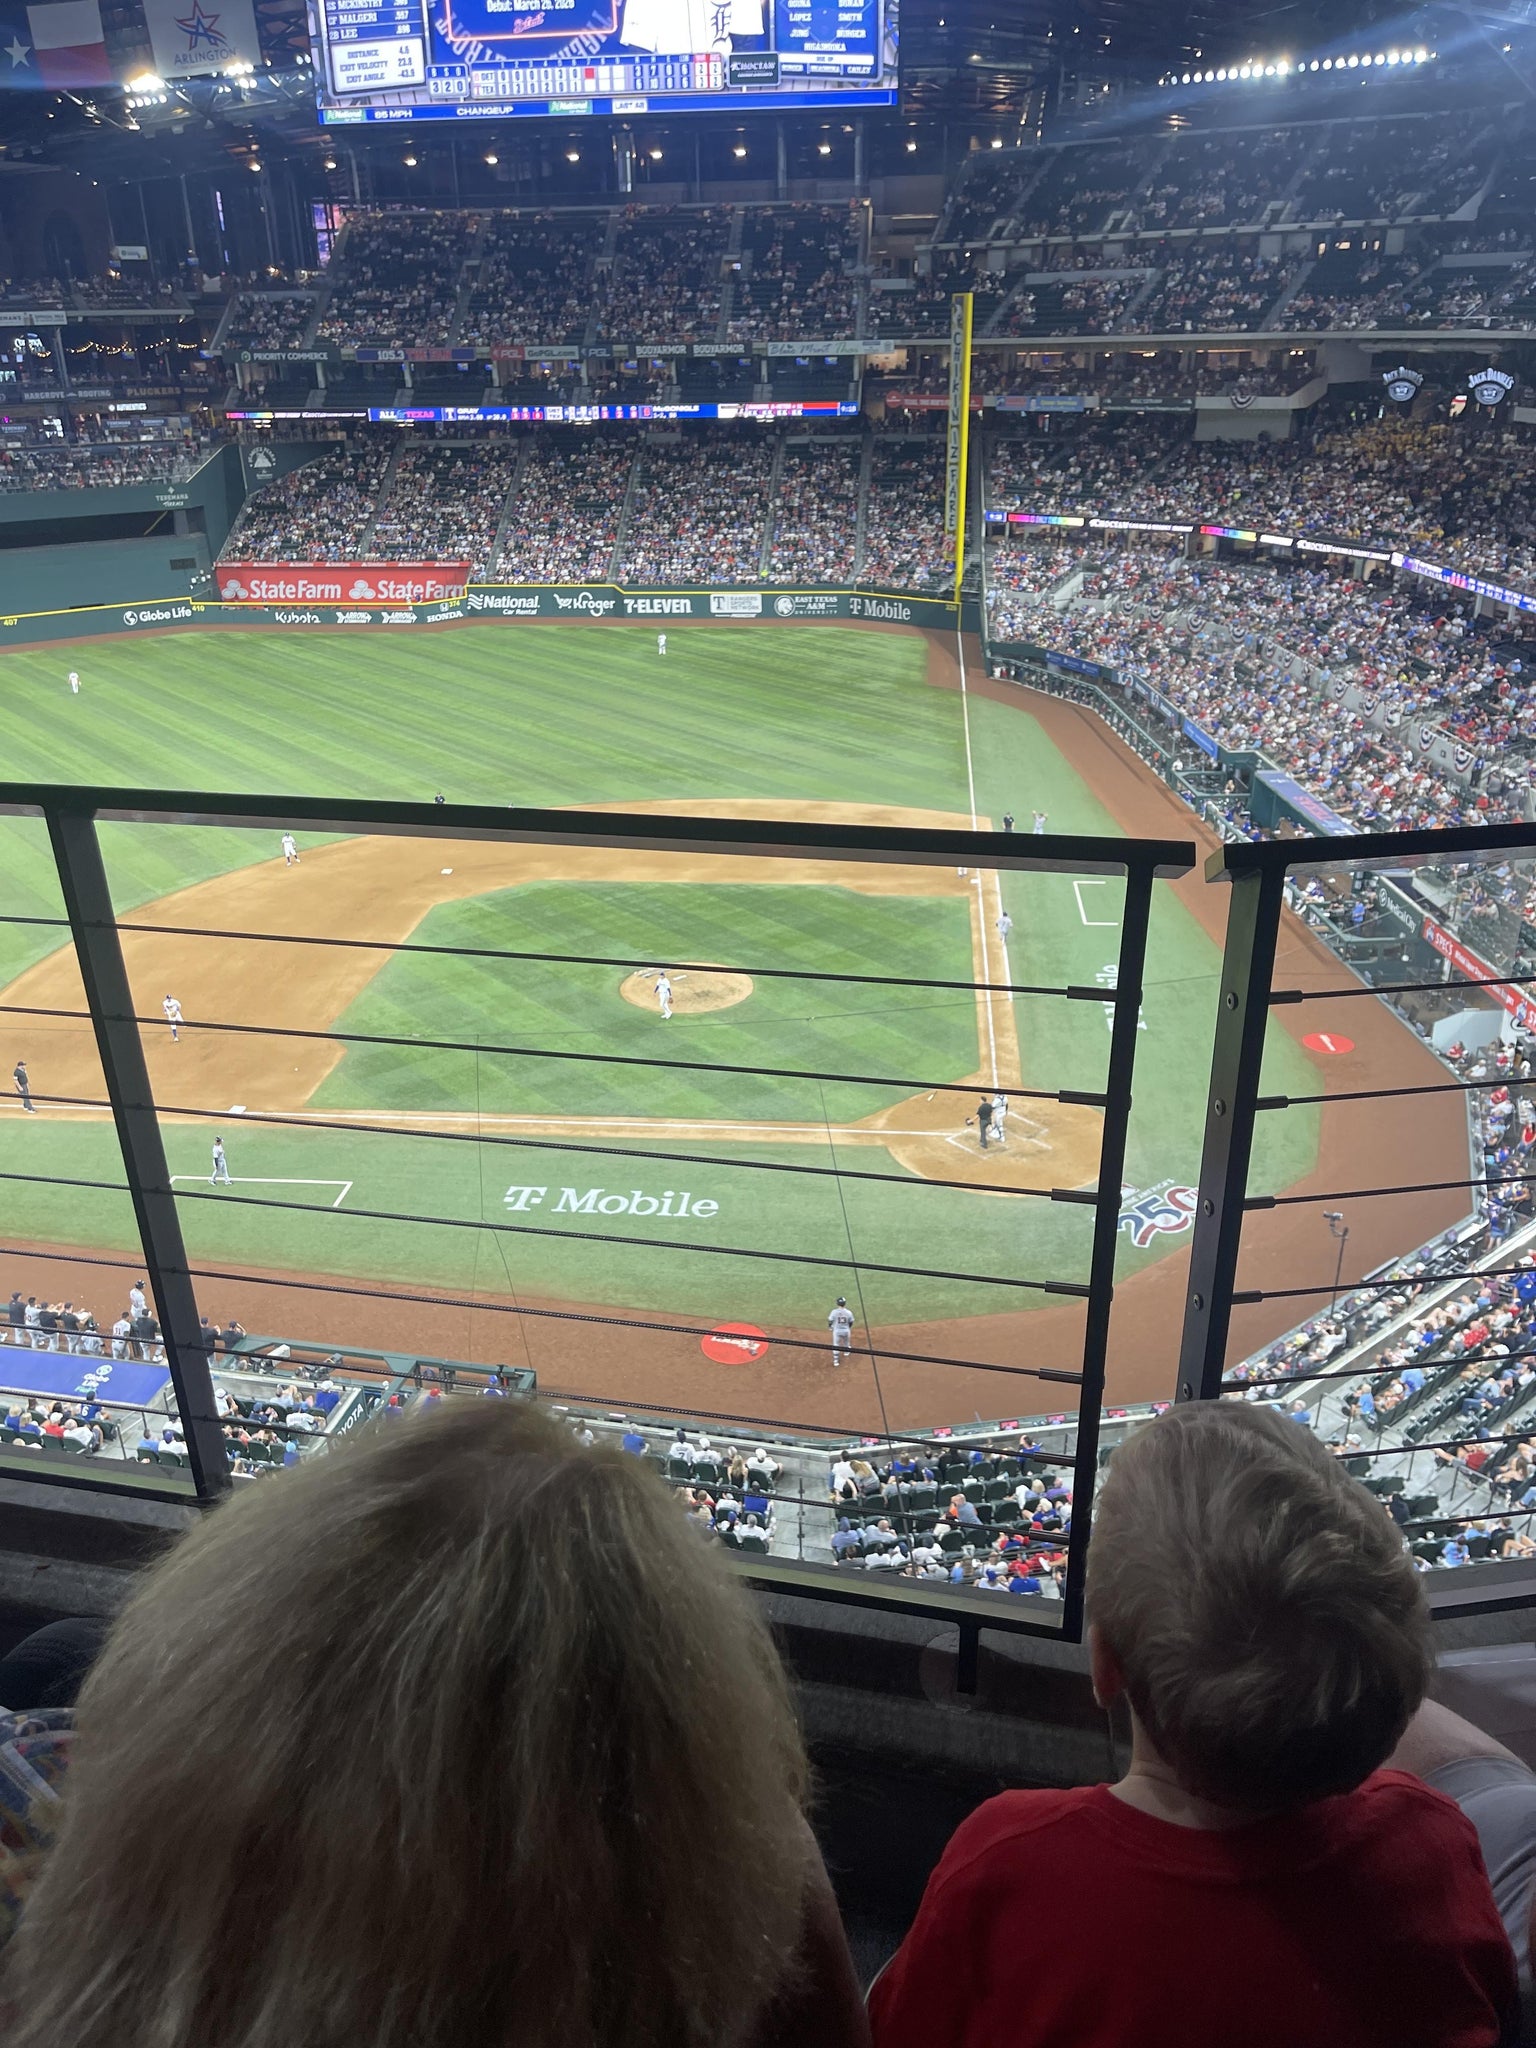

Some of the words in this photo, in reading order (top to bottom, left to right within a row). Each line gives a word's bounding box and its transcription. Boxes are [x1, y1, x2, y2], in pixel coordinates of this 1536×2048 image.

[341, 29, 358, 39] LEE
[174, 48, 236, 65] ARLINGTON
[433, 81, 438, 92] 3
[445, 81, 451, 92] 2
[457, 80, 463, 91] 0
[389, 110, 412, 118] MPH
[457, 106, 513, 116] CHANGEUP
[501, 349, 523, 359] PGL
[589, 348, 611, 358] PGL
[636, 346, 686, 355] BODYARMOR
[693, 345, 745, 354] BODYARMOR
[253, 352, 286, 361] PRIORITY
[287, 352, 329, 360] COMMERCE
[378, 350, 405, 360] 105.3
[1468, 370, 1487, 389] JACK
[24, 391, 65, 400] HARGROVE
[126, 387, 181, 396] PLUCKERS
[380, 410, 397, 419] ALL
[406, 410, 435, 419] TEXAS
[483, 595, 539, 609] National
[573, 591, 615, 617] Kroger
[139, 610, 171, 622] Globe
[172, 607, 192, 619] Life
[864, 600, 911, 621] Mobile
[275, 612, 321, 624] Kubota
[426, 610, 464, 623] HONDA
[3, 618, 18, 626] 407
[1387, 896, 1407, 920] Medical
[551, 1187, 719, 1218] Mobile
[838, 1316, 847, 1324] 13
[81, 1405, 89, 1417] 6
